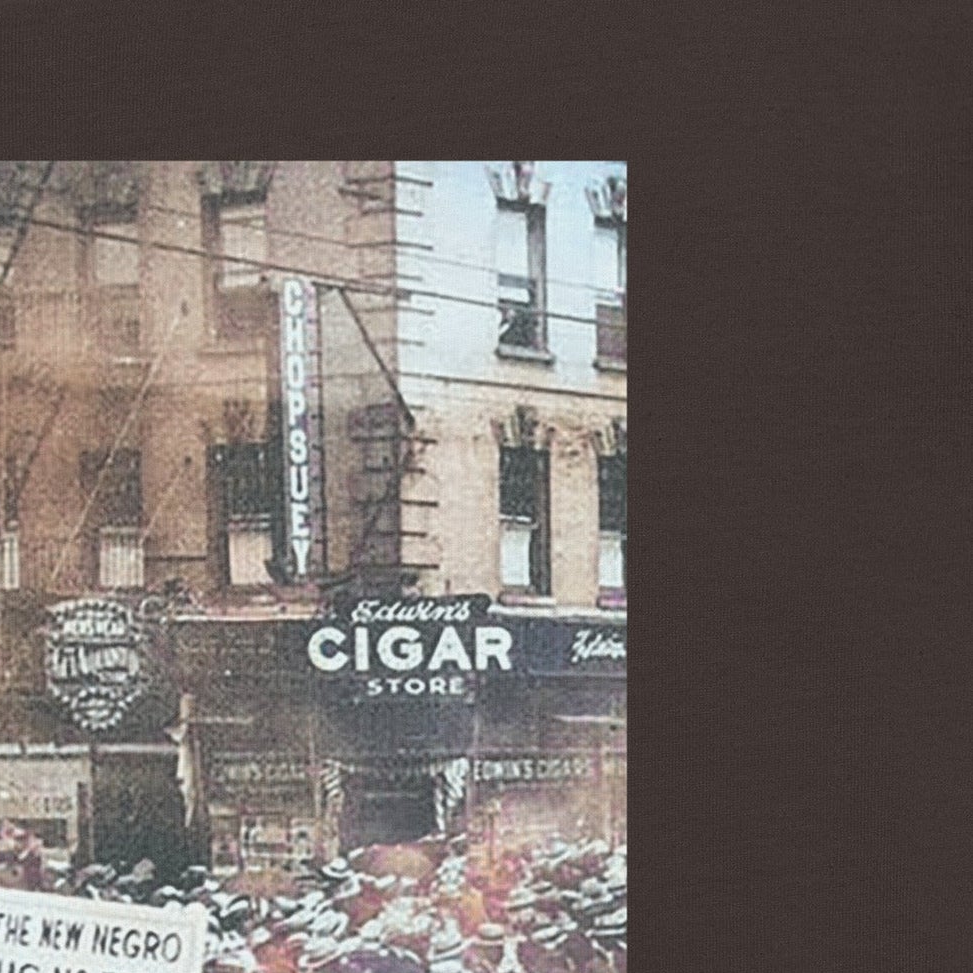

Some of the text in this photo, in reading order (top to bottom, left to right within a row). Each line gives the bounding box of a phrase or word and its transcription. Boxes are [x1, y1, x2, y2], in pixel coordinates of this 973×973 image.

[350, 600, 472, 624] Edwin's
[307, 625, 514, 672] CIGAR
[366, 677, 465, 696] STORE
[38, 917, 85, 951] NEW
[91, 923, 183, 964] NEGRO
